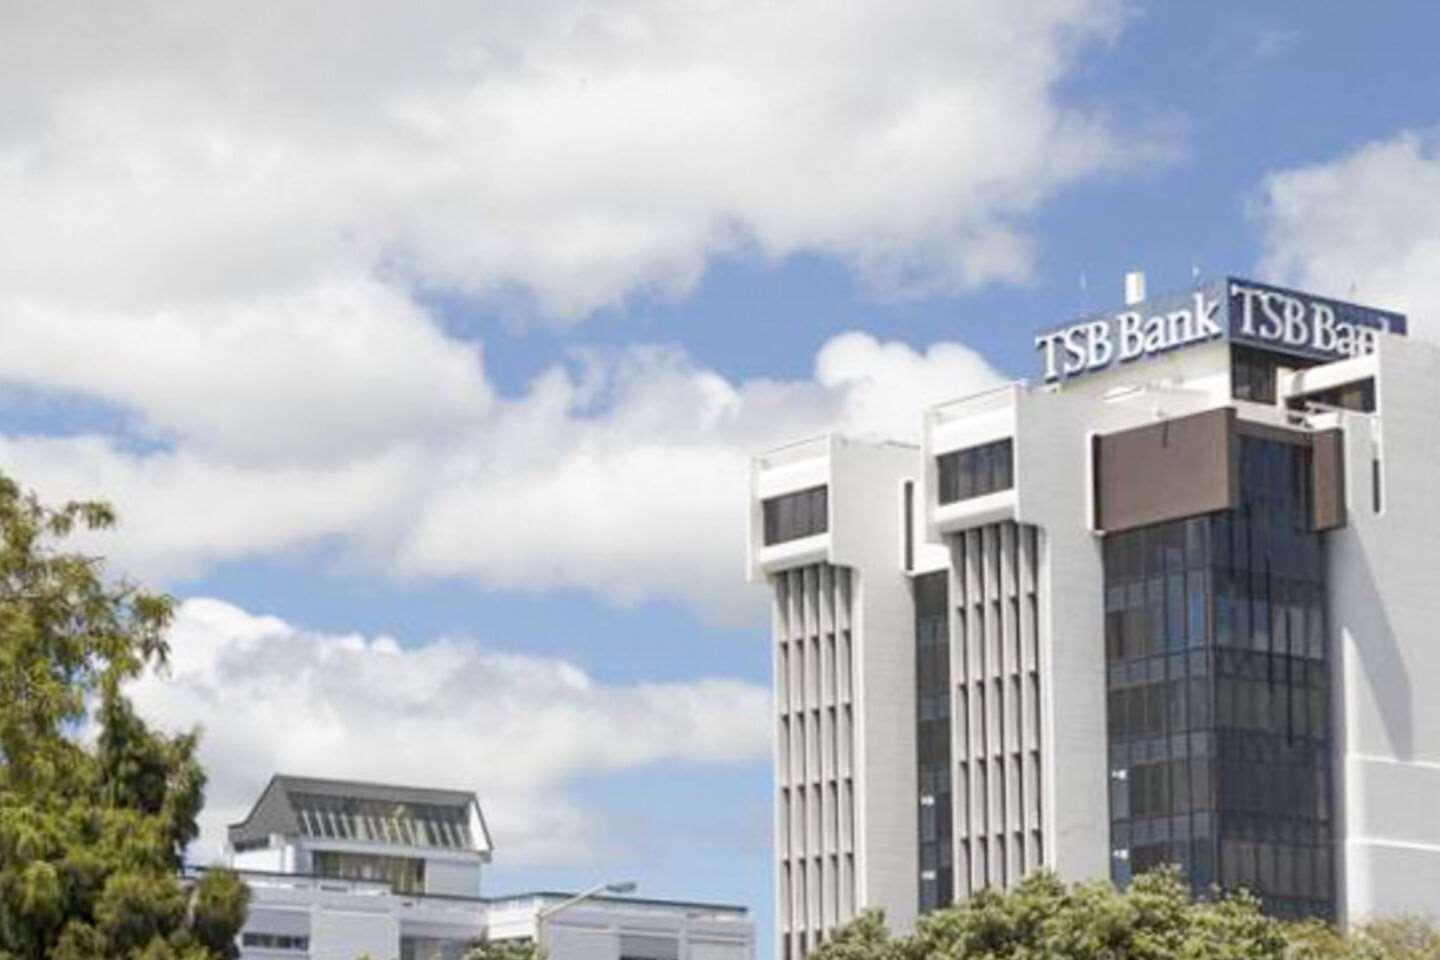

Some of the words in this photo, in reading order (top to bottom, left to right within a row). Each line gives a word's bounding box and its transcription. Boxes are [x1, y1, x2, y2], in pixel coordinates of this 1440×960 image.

[1035, 320, 1113, 379] TSB
[1116, 292, 1222, 360] Bank
[1231, 284, 1309, 345] TSB
[1312, 302, 1390, 358] Ban
